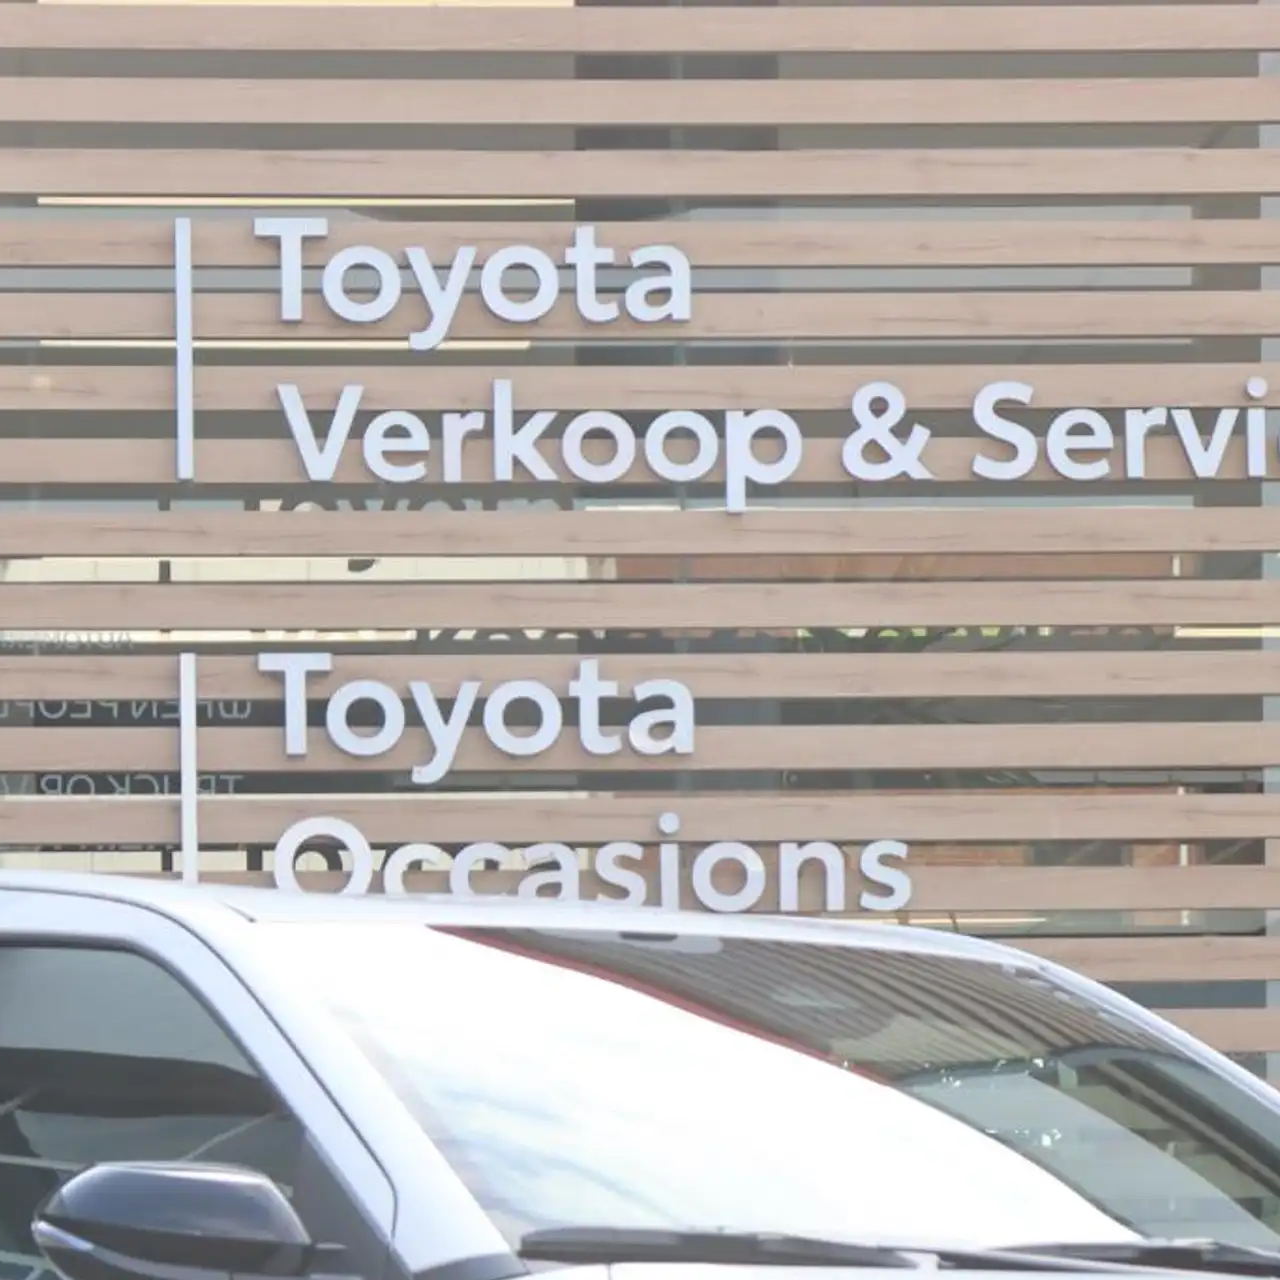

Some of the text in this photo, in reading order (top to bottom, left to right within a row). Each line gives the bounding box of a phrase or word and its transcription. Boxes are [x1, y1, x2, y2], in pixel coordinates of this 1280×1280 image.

[253, 216, 694, 351] Toyota
[275, 378, 805, 515] Verkoop
[839, 379, 934, 484] &
[256, 651, 698, 786] Toyota
[270, 811, 915, 916] Occasions
